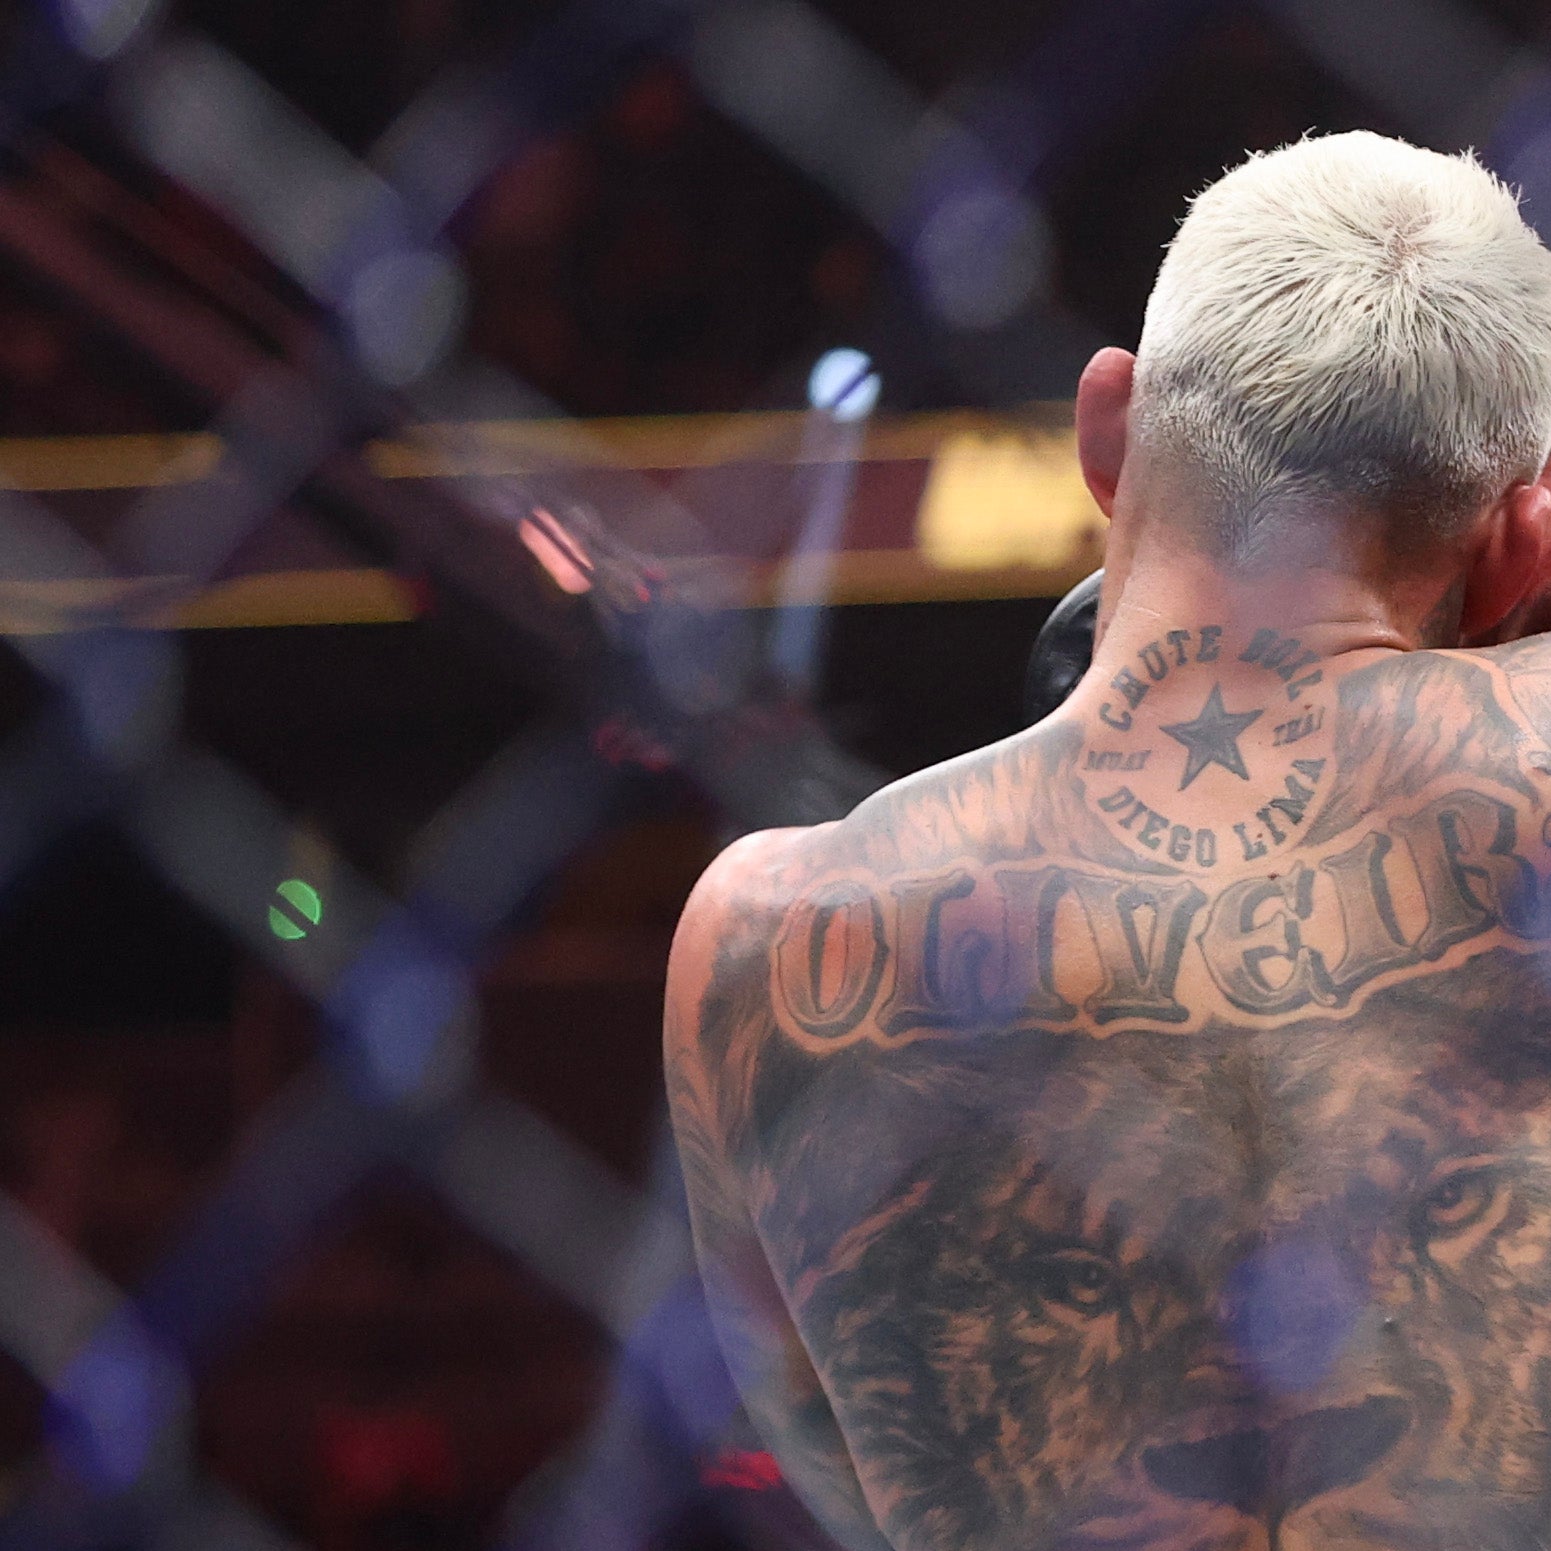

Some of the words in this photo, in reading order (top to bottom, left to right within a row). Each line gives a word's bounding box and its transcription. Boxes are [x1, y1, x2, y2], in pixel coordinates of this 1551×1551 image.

[1100, 625, 1222, 732] CHUTE
[1097, 786, 1217, 867] DIEGO
[1233, 758, 1326, 862] LIMA
